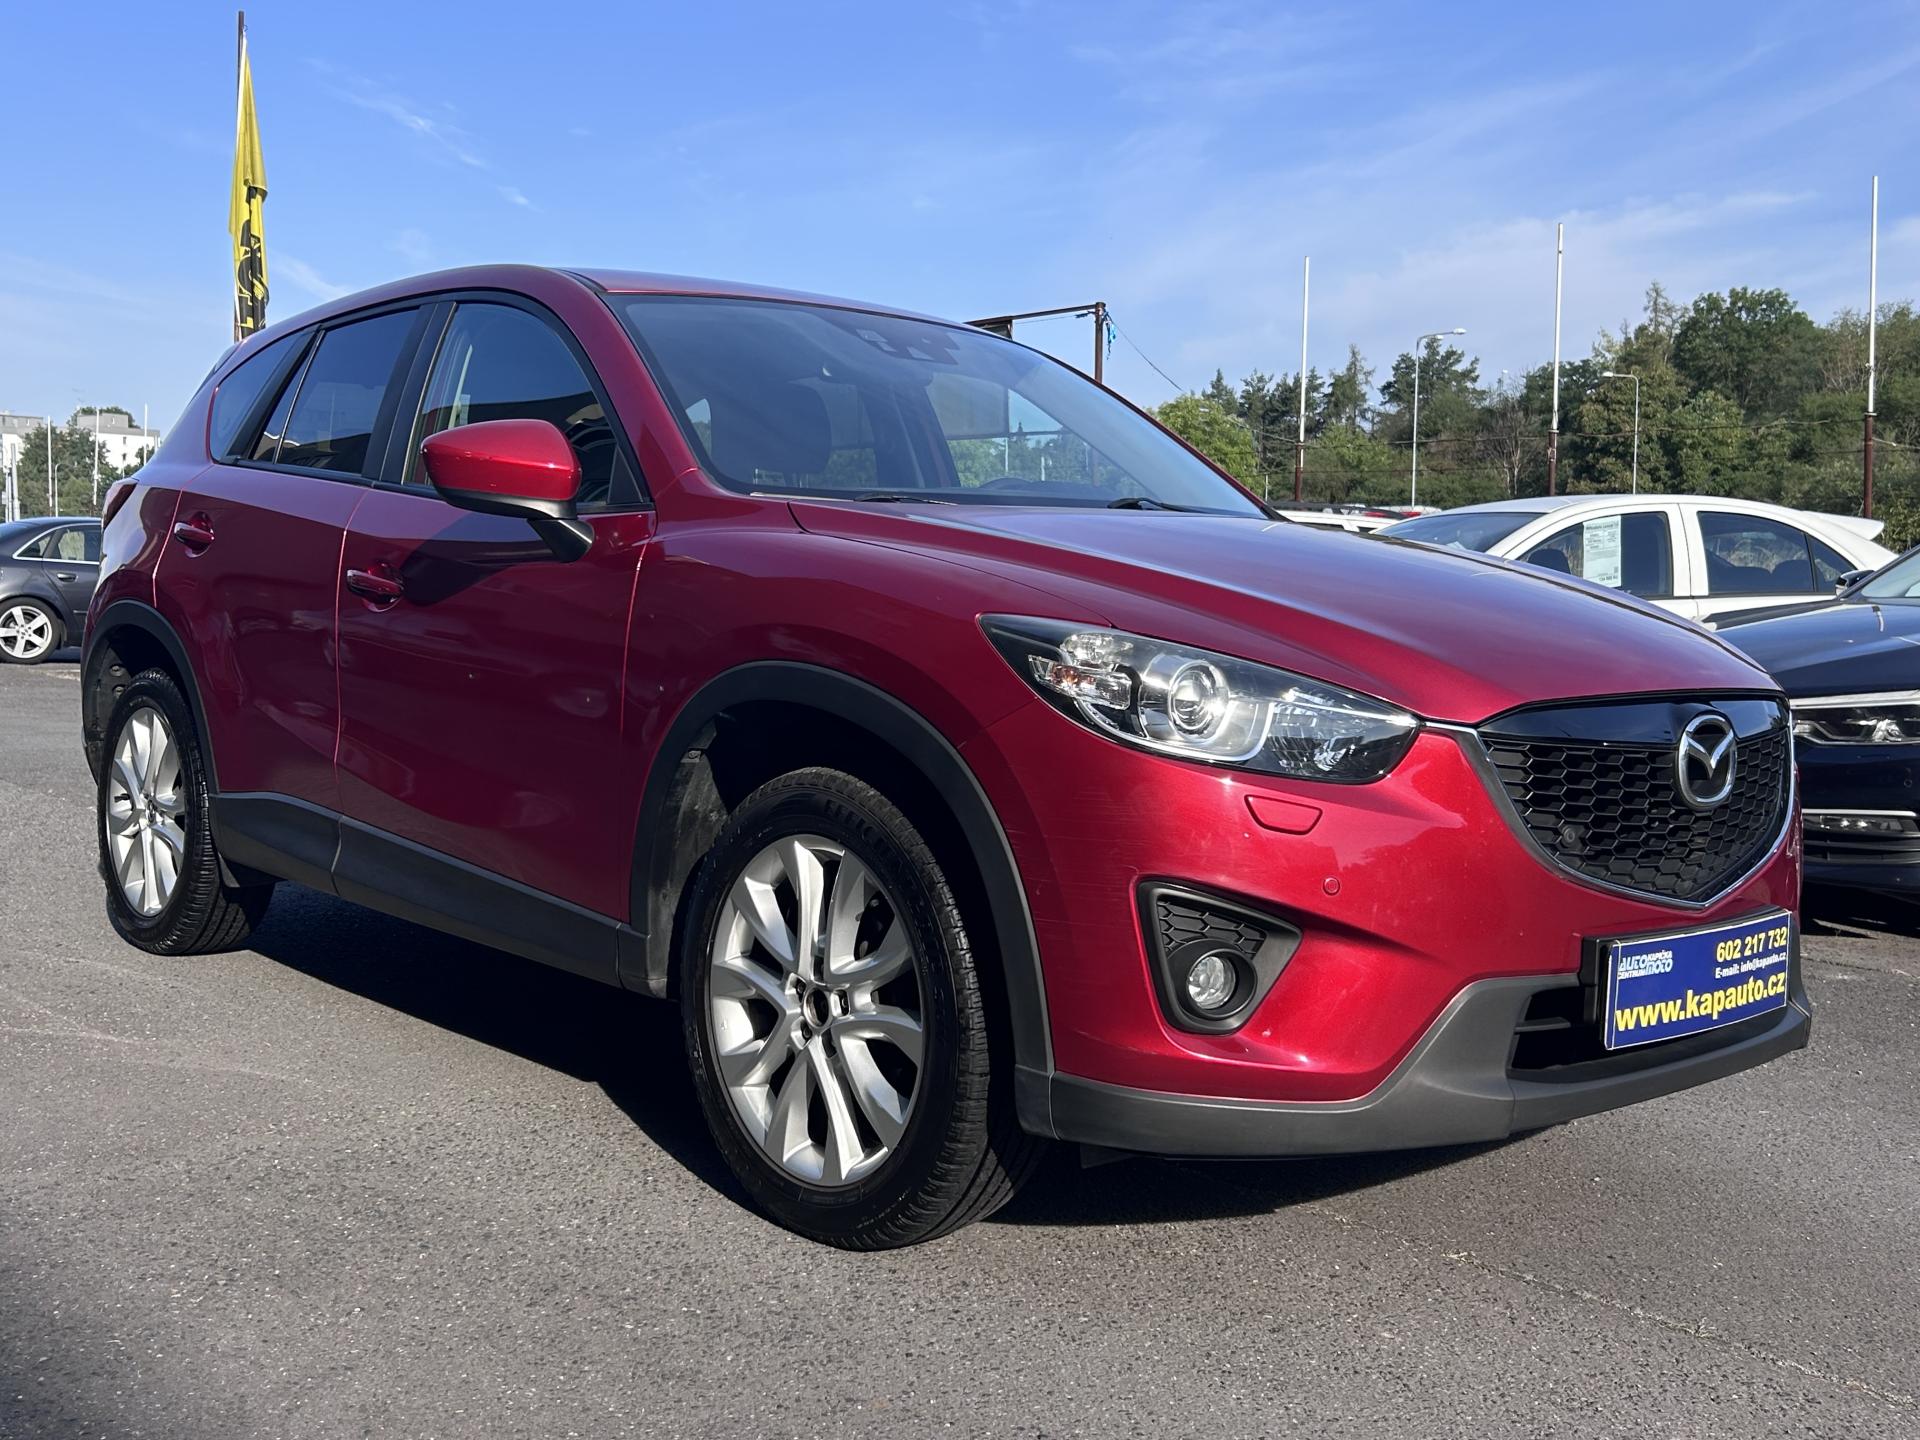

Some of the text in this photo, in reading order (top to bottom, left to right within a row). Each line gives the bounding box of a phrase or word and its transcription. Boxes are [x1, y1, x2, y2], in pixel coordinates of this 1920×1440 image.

[1716, 926, 1788, 963] 602 217 732
[1619, 954, 1648, 971] AUTO
[1715, 952, 1787, 979] E-mail: info@kapauto.cz
[1615, 972, 1786, 1032] www.kapauto.cz
